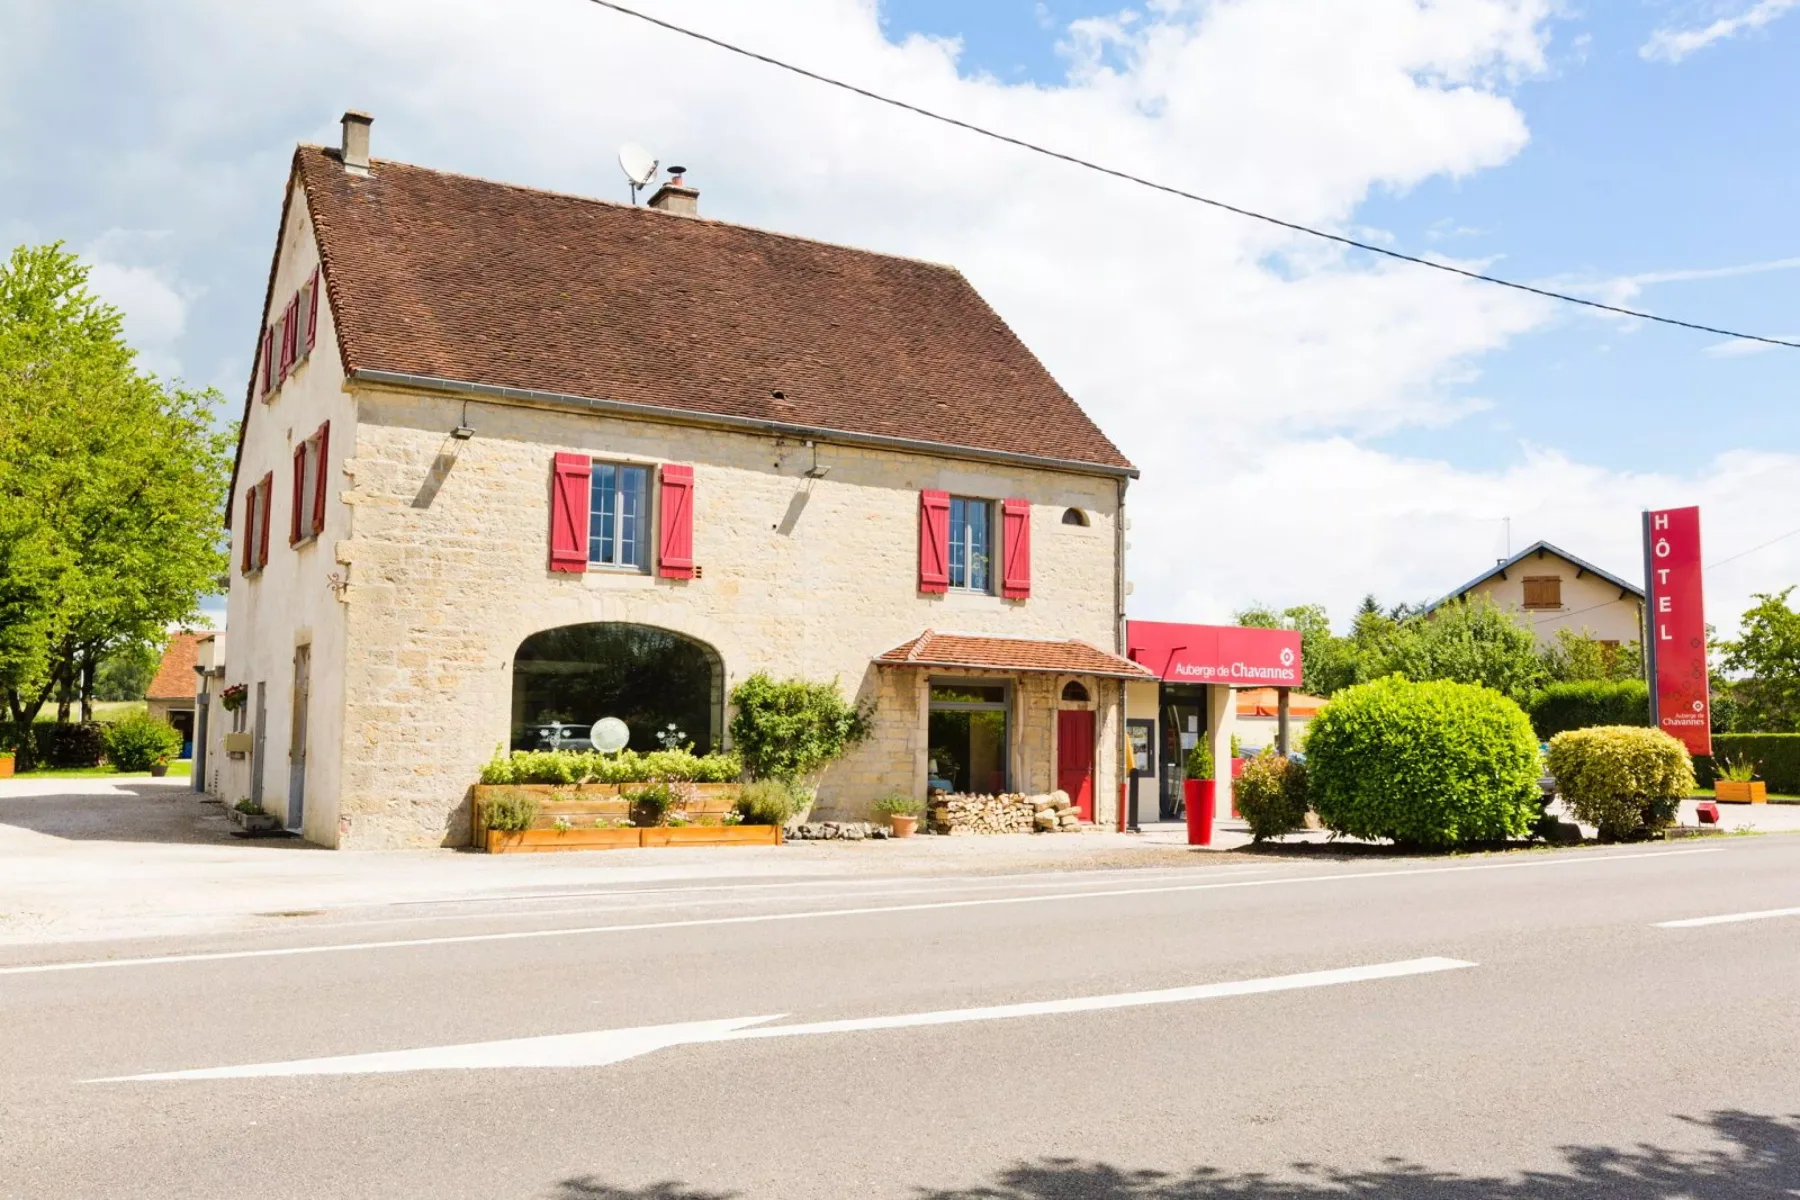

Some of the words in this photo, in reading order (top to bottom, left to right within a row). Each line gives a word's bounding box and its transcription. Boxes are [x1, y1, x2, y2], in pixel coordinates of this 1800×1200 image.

[1655, 514, 1672, 640] HÔTEL
[1175, 663, 1216, 678] Auberge
[1217, 665, 1229, 676] de
[1231, 662, 1295, 680] Chavannes
[1662, 717, 1705, 726] Chavannes
